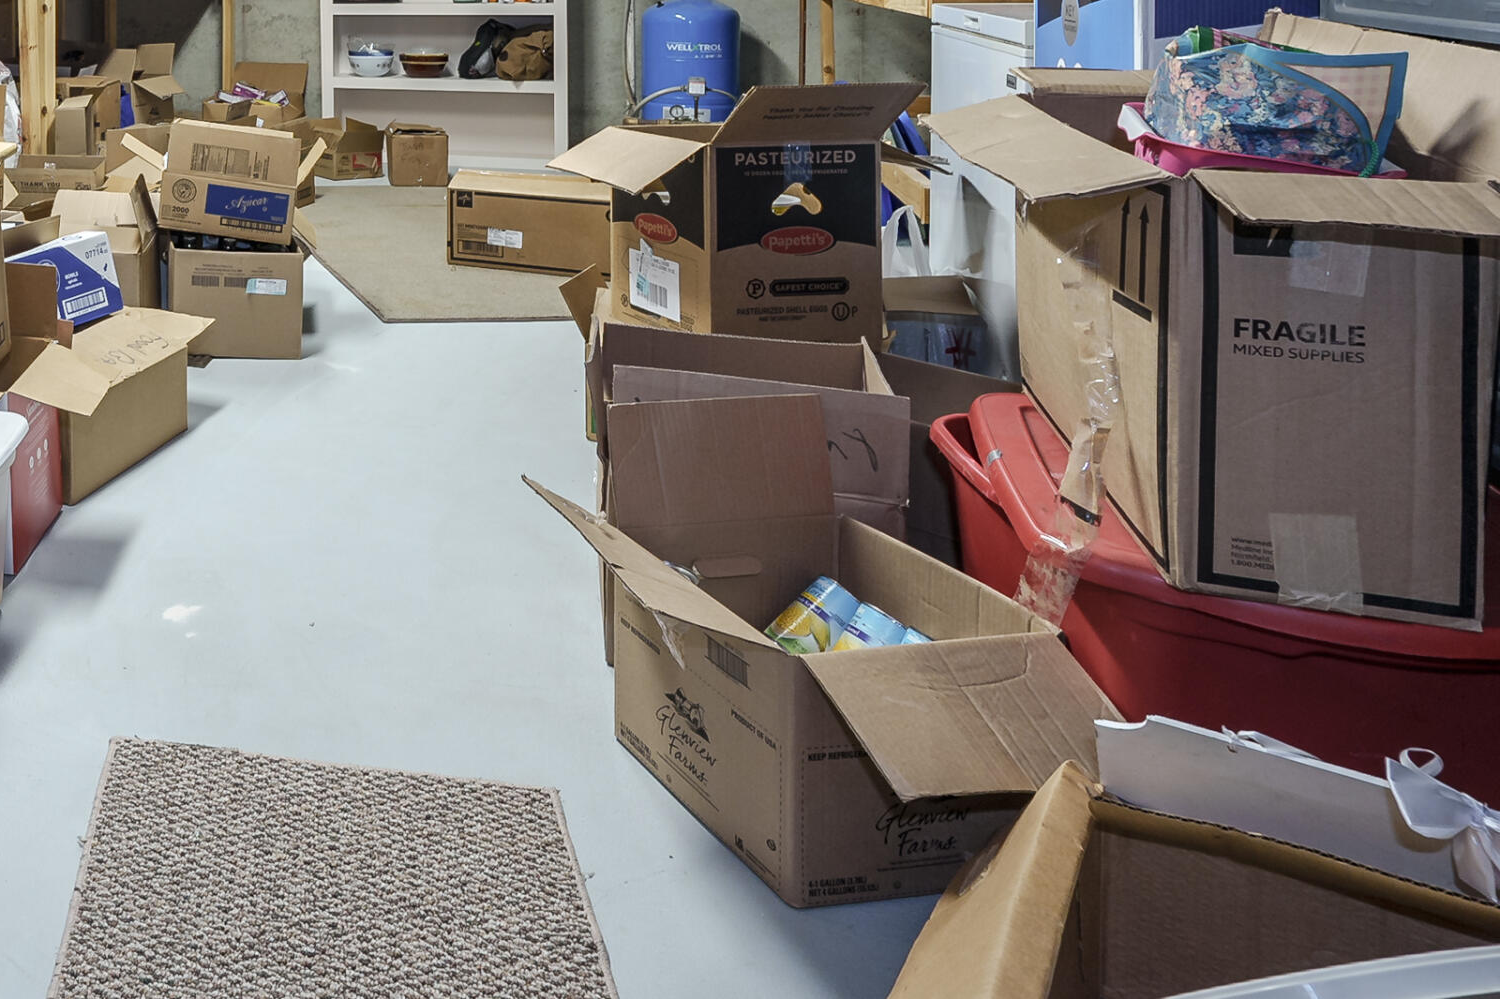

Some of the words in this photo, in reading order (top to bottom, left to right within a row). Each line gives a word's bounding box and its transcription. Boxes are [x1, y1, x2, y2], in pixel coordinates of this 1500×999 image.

[734, 149, 857, 166] PASTEURIZED
[20, 180, 44, 188] THANK
[46, 181, 61, 189] YOU
[172, 206, 190, 215] 2000
[85, 247, 104, 260] 07714
[808, 281, 839, 291] CHOICE
[737, 306, 785, 317] PASTEURIZED
[786, 305, 808, 315] SHELL
[1234, 318, 1366, 348] FRAGILE
[1233, 343, 1284, 359] MIXED
[1288, 347, 1365, 364] SUPPLIES
[731, 709, 755, 732] PRODUCT
[656, 704, 717, 767] Glenview
[668, 734, 708, 783] Farms
[808, 752, 826, 762] KEEP
[875, 802, 970, 845] Glenview
[820, 877, 846, 887] GALLON
[828, 886, 855, 896] GALLONS
